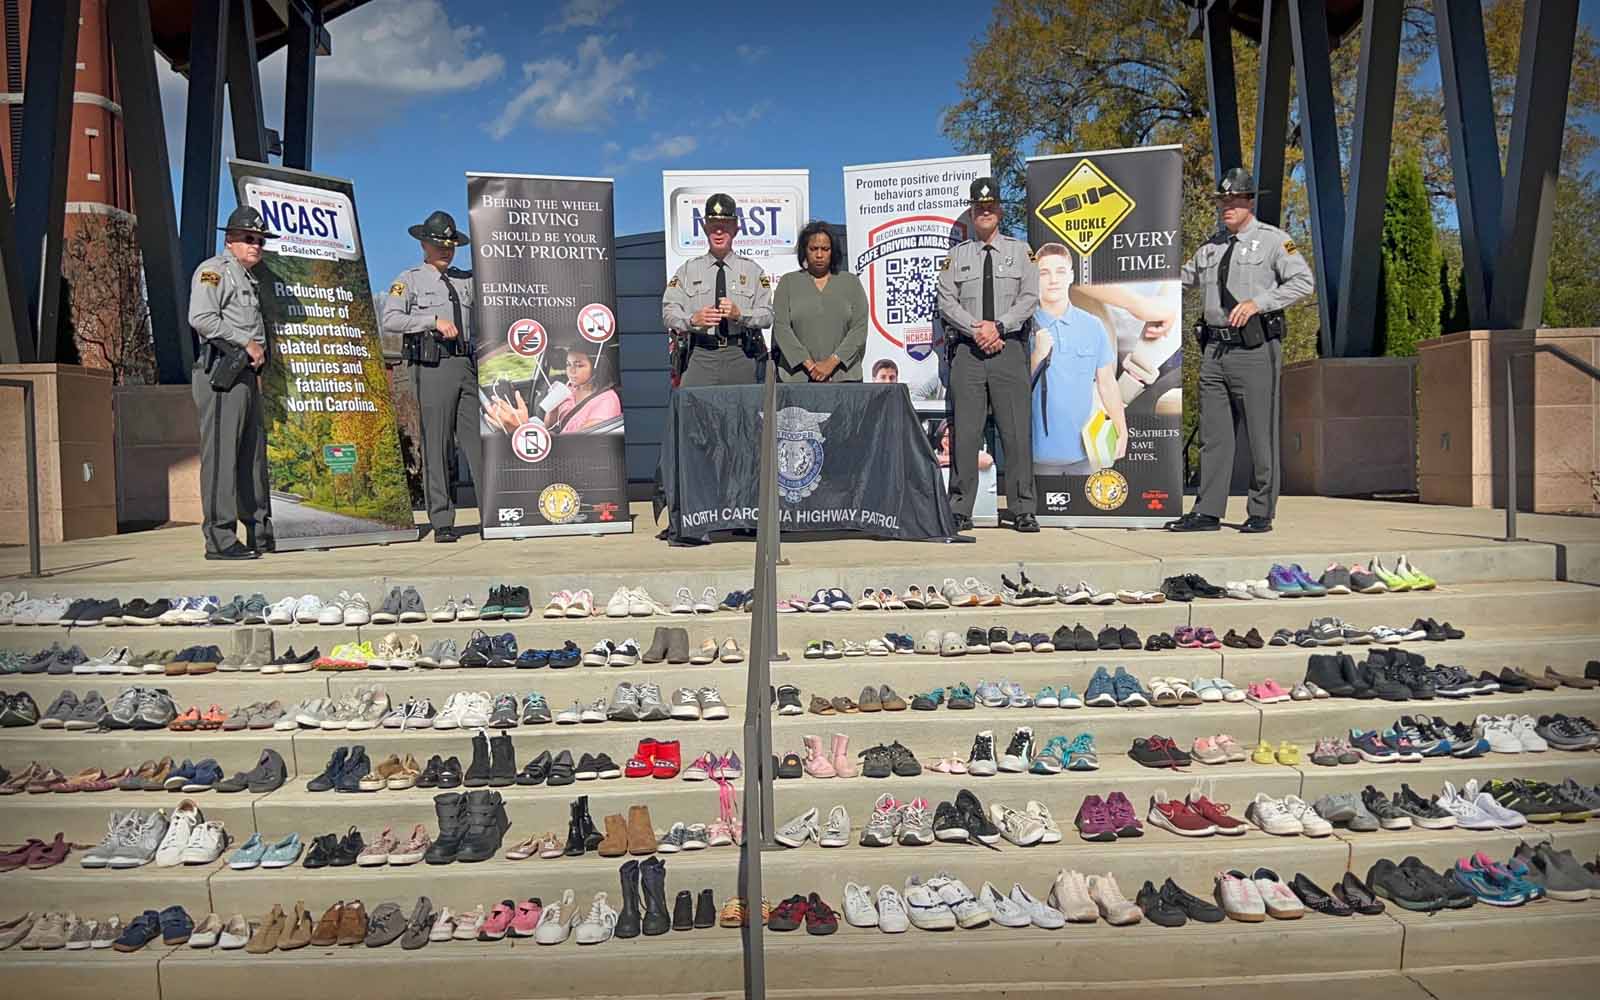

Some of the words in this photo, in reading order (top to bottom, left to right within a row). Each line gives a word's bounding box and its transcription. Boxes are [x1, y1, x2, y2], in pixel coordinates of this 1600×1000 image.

[856, 178, 898, 189] Promote
[900, 174, 939, 188] positive
[942, 170, 977, 182] driving
[874, 188, 923, 201] behaviors
[925, 185, 959, 197] among
[482, 195, 531, 209] BEHIND
[534, 199, 558, 210] THE
[561, 200, 603, 212] WHEEL
[859, 203, 894, 215] friends
[897, 200, 915, 212] and
[918, 197, 972, 210] classmate
[261, 200, 339, 240] NCAST
[508, 211, 579, 227] DRIVING
[692, 206, 782, 237] NAST
[1065, 217, 1107, 231] BUCKLE
[491, 231, 541, 243] SHOULD
[544, 232, 560, 243] BE
[563, 233, 598, 244] YOUR
[876, 228, 904, 243] BECOME
[905, 225, 916, 235] AN
[917, 223, 940, 233] NCAST
[1079, 231, 1094, 243] UP
[1113, 230, 1177, 249] EVERY
[280, 245, 337, 259] BeSafeNC.org
[480, 244, 528, 259] ONLY
[530, 246, 609, 260] PRIORITY.
[859, 248, 880, 269] SAFE
[879, 237, 917, 255] DRIVING
[1117, 254, 1171, 272] TIME.
[274, 282, 334, 303] Reducing
[335, 286, 354, 302] the
[482, 283, 548, 295] ELIMINATE
[482, 296, 577, 308] DISTRACTIONS!
[288, 304, 336, 318] number
[338, 305, 350, 320] of
[323, 342, 372, 360] crashes,
[290, 359, 342, 376] injuries
[344, 360, 363, 375] and
[296, 377, 353, 394] fatalities
[354, 380, 366, 394] in
[287, 397, 324, 412] North
[325, 397, 379, 413] Carolina.
[1128, 427, 1180, 439] SEATBELTS
[1131, 441, 1154, 450] SAVE
[1128, 453, 1158, 462] LIVES.
[682, 509, 719, 528] NORTH
[721, 507, 793, 523] CAROA
[796, 509, 858, 523] HIGHWAY
[860, 510, 900, 529] PATROL
